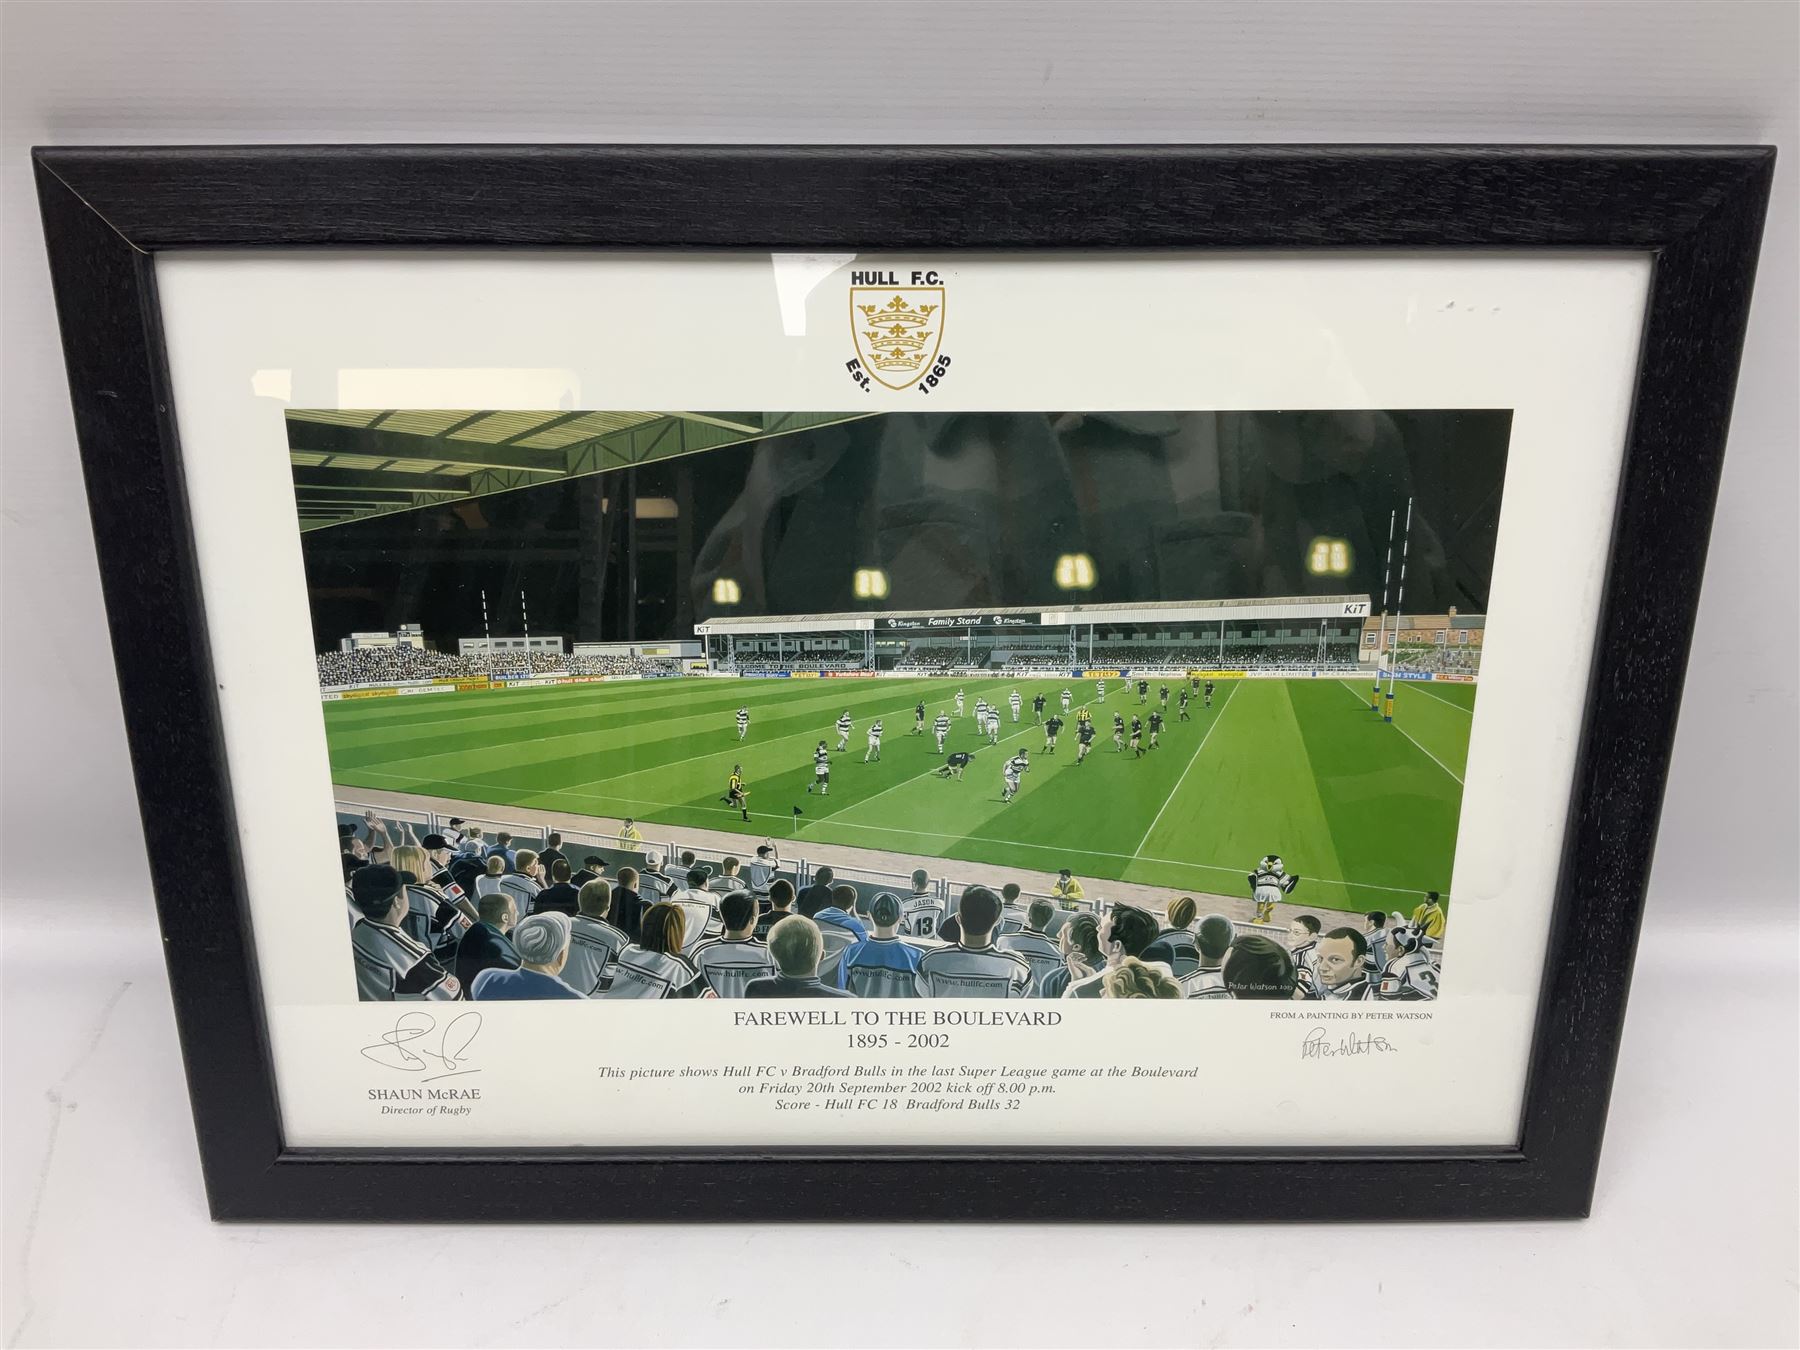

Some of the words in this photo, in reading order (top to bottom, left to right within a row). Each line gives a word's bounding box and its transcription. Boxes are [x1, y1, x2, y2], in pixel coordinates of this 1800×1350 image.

[851, 271, 899, 285] HULL
[911, 271, 944, 285] F.C.
[845, 358, 871, 393] Est.
[918, 355, 952, 395] 1865
[928, 617, 955, 627] Family
[956, 616, 982, 625] Stand
[913, 898, 935, 908] JASON
[916, 916, 934, 937] 13
[733, 1011, 847, 1026] FAREWELL
[851, 1011, 879, 1026] TO
[885, 1011, 926, 1026] THE
[932, 1011, 1062, 1026] BOULEVARD
[1270, 1011, 1296, 1019] FROM
[1306, 1012, 1349, 1020] PAINTING
[1351, 1012, 1364, 1020] BY
[1366, 1012, 1394, 1020] PETER
[1396, 1012, 1433, 1020] WATSON
[847, 1033, 887, 1049] 1895
[907, 1033, 950, 1049] 2002
[598, 1066, 625, 1077] This
[628, 1066, 675, 1080] picture
[680, 1066, 718, 1077] shows
[723, 1066, 751, 1077] Hull
[755, 1066, 776, 1077] FC
[781, 1069, 788, 1077] v
[791, 1066, 851, 1078] Bradford
[853, 1066, 887, 1077] Bulls
[890, 1066, 903, 1077] in
[907, 1066, 928, 1077] the
[931, 1065, 955, 1077] last
[958, 1066, 996, 1080] Super
[999, 1066, 1047, 1080] League
[1050, 1068, 1087, 1080] game
[1090, 1067, 1104, 1077] at
[1107, 1066, 1128, 1077] the
[1130, 1066, 1199, 1077] Boulevard
[368, 1088, 422, 1100] SHAUN
[428, 1088, 481, 1100] McRAE
[738, 1086, 755, 1094] on
[760, 1082, 803, 1096] Friday
[806, 1082, 835, 1093] 20th
[838, 1082, 908, 1096] September
[911, 1082, 942, 1093] 2002
[945, 1082, 972, 1093] kick
[974, 1082, 996, 1096] off
[997, 1083, 1026, 1094] 8.00
[1028, 1085, 1056, 1097] p.m.
[380, 1105, 424, 1115] Director
[426, 1105, 438, 1117] of
[439, 1105, 472, 1116] Rugby
[774, 1099, 811, 1110] Score
[824, 1098, 853, 1110] Hull
[857, 1099, 878, 1110] FC
[882, 1099, 898, 1110] 18
[905, 1098, 965, 1112] Bradford
[967, 1098, 1001, 1110] Bulls
[1003, 1099, 1021, 1110] 32
